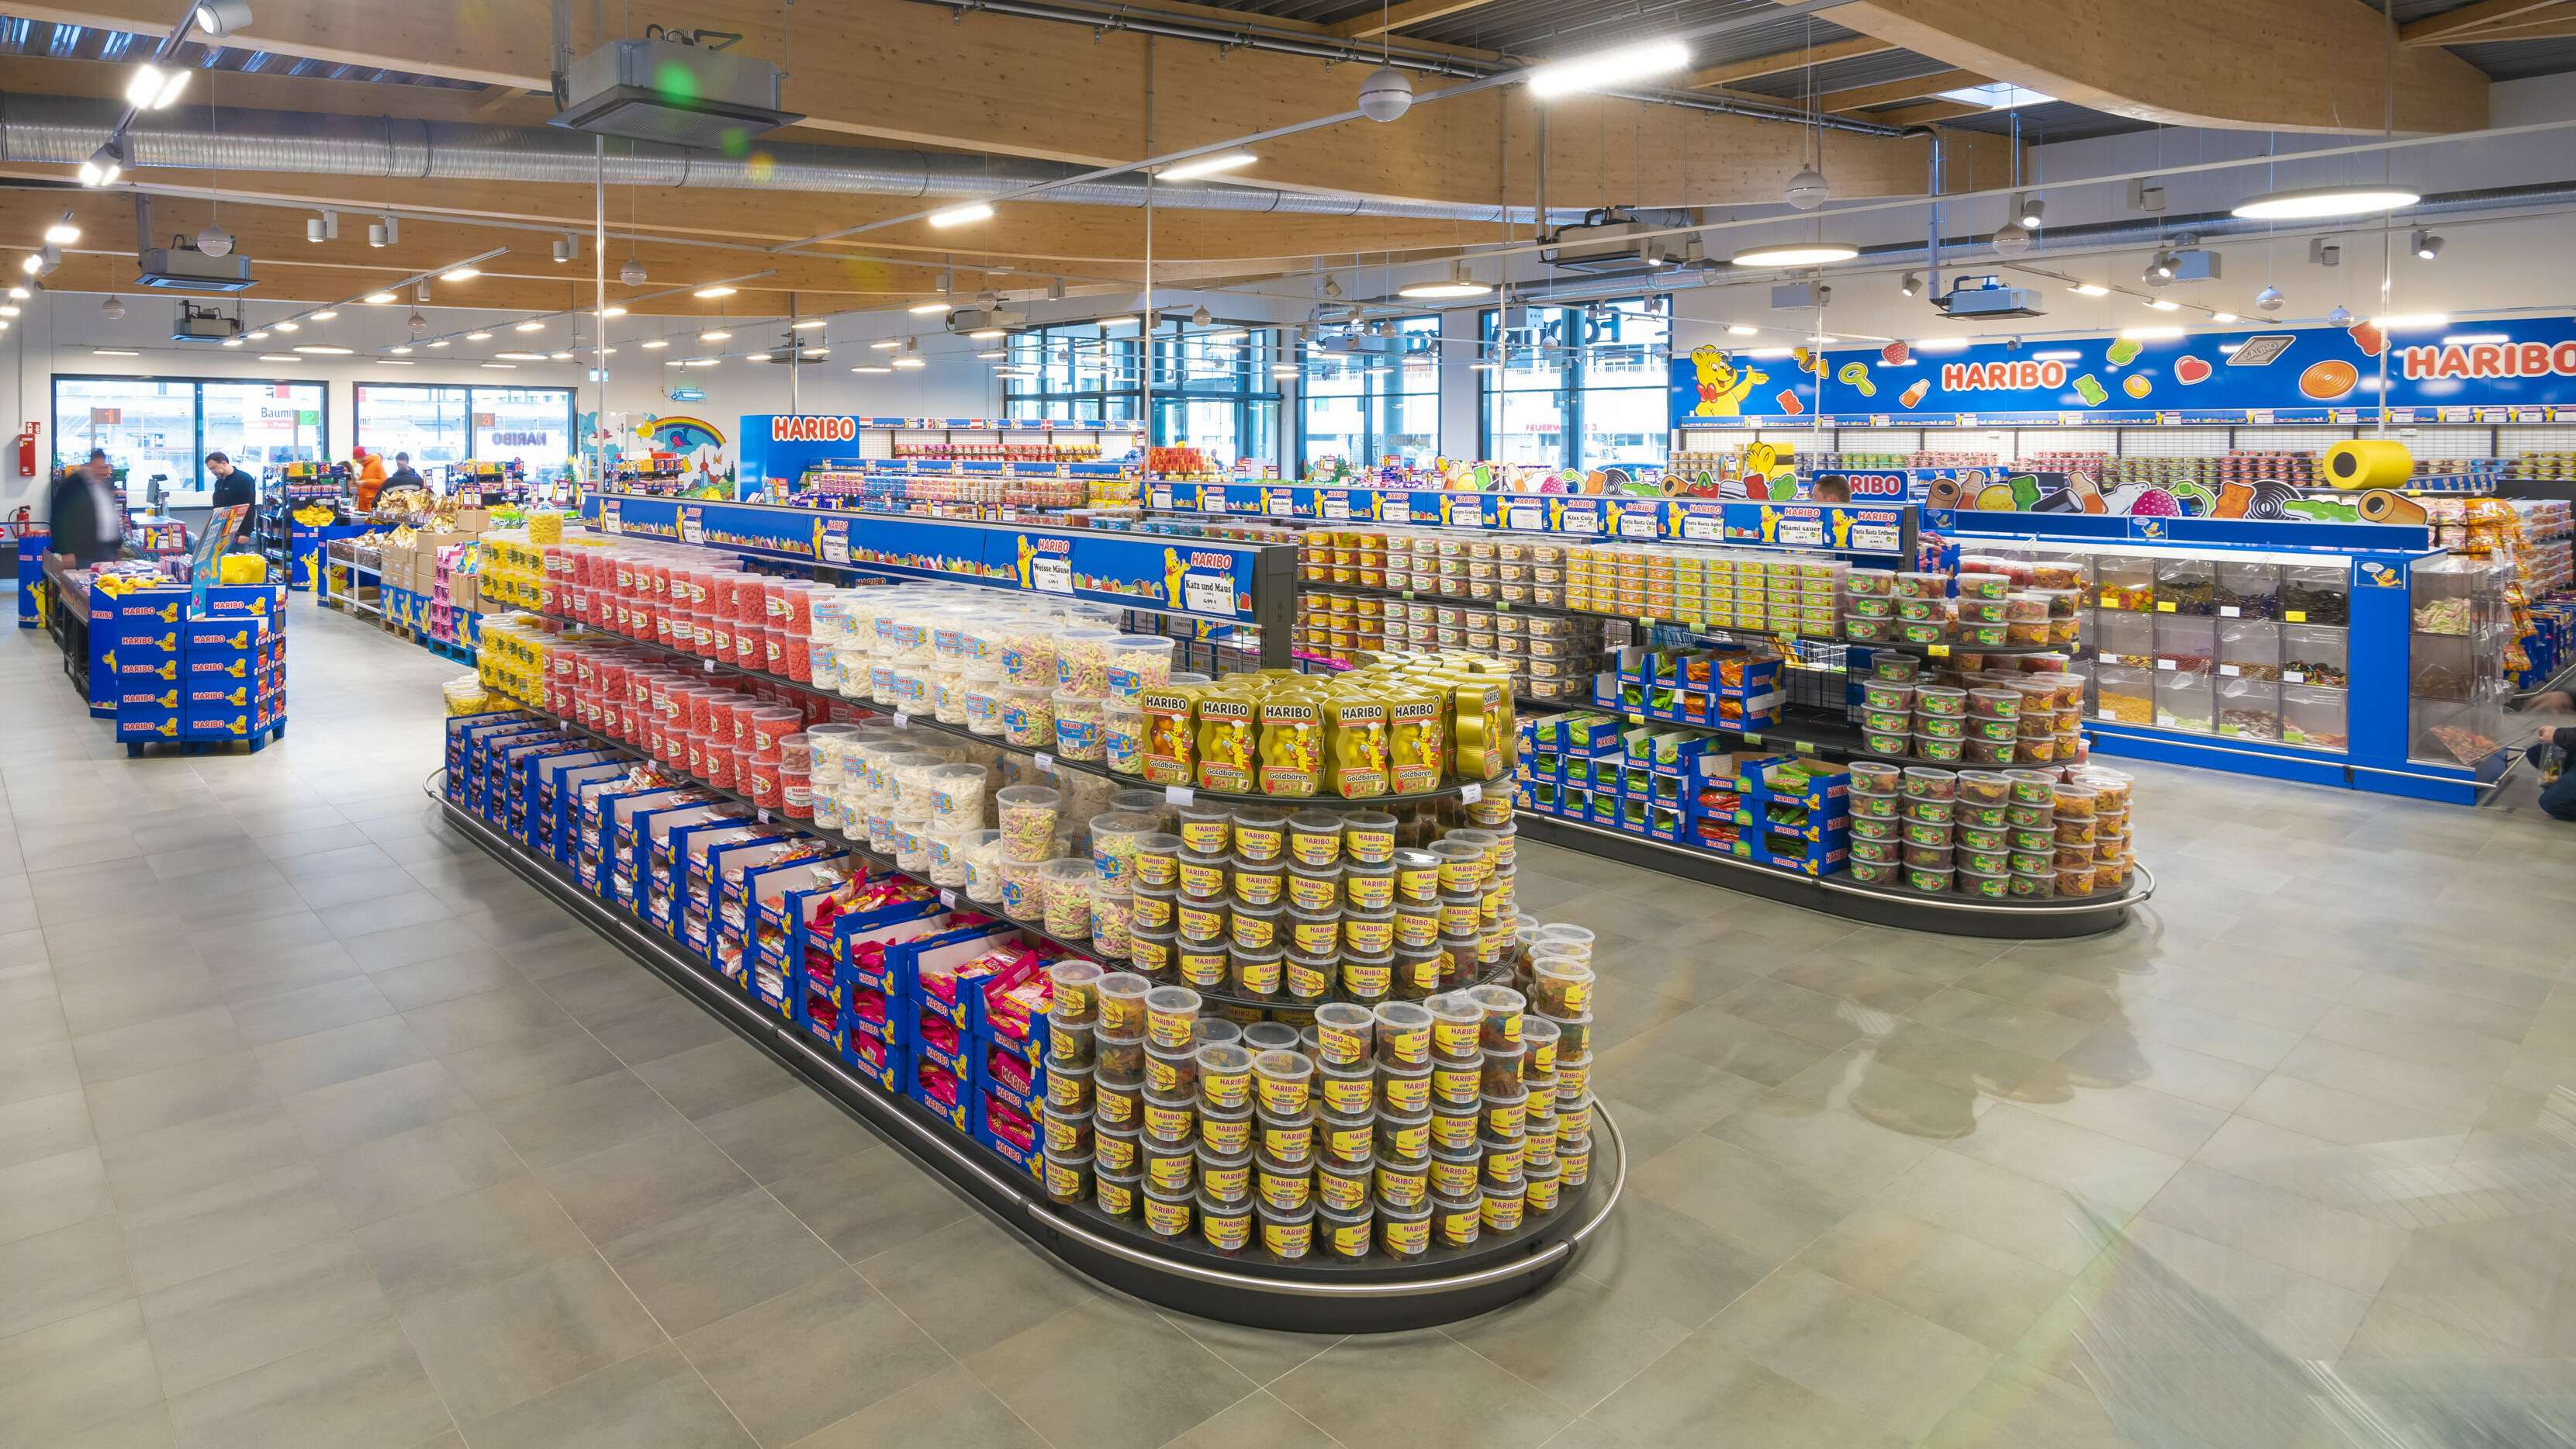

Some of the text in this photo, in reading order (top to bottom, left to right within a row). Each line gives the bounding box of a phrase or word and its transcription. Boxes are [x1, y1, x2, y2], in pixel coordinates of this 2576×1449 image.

[2408, 344, 2576, 377] HARIBO
[1944, 362, 2064, 389] HARIBO
[773, 417, 855, 440] HARIBO
[1850, 476, 1900, 494] RIBO
[1626, 503, 1655, 512] HARIBO
[1689, 504, 1721, 514] HARIBO
[1785, 507, 1820, 517] HARIBO
[1858, 511, 1897, 521] HARIBO
[827, 520, 848, 531] HARIBO
[1038, 538, 1070, 553] HARIBO
[1191, 552, 1232, 569] HARIBO
[1034, 563, 1070, 574] Weisse Mäuse
[1185, 579, 1232, 593] Katz und Maus
[213, 601, 244, 610] HARIBO
[91, 610, 112, 619] HARIBO
[123, 607, 155, 615] HARIBO
[122, 636, 154, 645] HARIBO
[194, 635, 225, 644] HARIBO
[192, 663, 223, 672] HARIBO
[123, 694, 155, 703] HARIBO
[1483, 690, 1500, 704] HARIBO
[1146, 696, 1187, 710] HARIBO
[1203, 702, 1248, 716] HARIBO
[1265, 705, 1312, 719] HARIBO
[1341, 706, 1382, 720] HARIBO
[1395, 704, 1433, 718] HARIBO
[123, 722, 155, 731] HARIBO
[193, 721, 224, 729] HARIBO
[1720, 721, 1741, 729] HARIBO
[1596, 734, 1617, 747] HARIBO
[1150, 760, 1184, 770] Goldbären
[1206, 768, 1244, 777] Goldbären
[1269, 773, 1308, 781] Goldbären
[1347, 773, 1380, 782] Goldbären
[1399, 770, 1432, 779] Goldbären
[1567, 779, 1588, 787] HARIBO
[1708, 779, 1733, 788] HARIBO
[1827, 785, 1848, 797] HARIBO
[1774, 795, 1800, 804] HARIBO
[1534, 804, 1554, 812] HARIBO
[1708, 811, 1732, 820] HARIBO
[1827, 817, 1849, 830] HARIBO
[1243, 831, 1270, 840] HARIBO
[1651, 831, 1674, 840] HARIBO
[1774, 826, 1800, 836] HARIBO
[1303, 836, 1329, 845] HARIBO
[1706, 840, 1731, 850] HARIBO
[1773, 857, 1798, 868] HARIBO
[1295, 880, 1321, 890] HARIBO
[761, 909, 778, 925] HARIBO
[1402, 917, 1428, 925] HARIBO
[1356, 923, 1383, 932] HARIBO
[809, 934, 828, 951] HARIBO
[859, 973, 879, 987] HARIBO
[761, 992, 778, 1008] HARIBO
[925, 995, 949, 1016] HARIBO
[1152, 1015, 1176, 1027] HARIBO
[859, 1020, 879, 1037] HARIBO
[1320, 1030, 1343, 1043] HARIBO
[994, 1032, 1020, 1053] HARIBO
[925, 1046, 950, 1067] HARIBO
[857, 1058, 877, 1079] HARIBO
[1338, 1083, 1365, 1091] HARIBO
[995, 1085, 1022, 1108] HARIBO
[924, 1095, 948, 1117] HARIBO
[1153, 1111, 1180, 1120] HARIBO
[1281, 1132, 1307, 1140] HARIBO
[995, 1140, 1022, 1164] HARIBO
[1439, 1165, 1468, 1175] HARIBO
[1271, 1178, 1298, 1188] HARIBO
[1323, 1175, 1348, 1188] HARIBO
[1150, 1203, 1176, 1215] HARIBO
[1492, 1201, 1518, 1209] HARIBO
